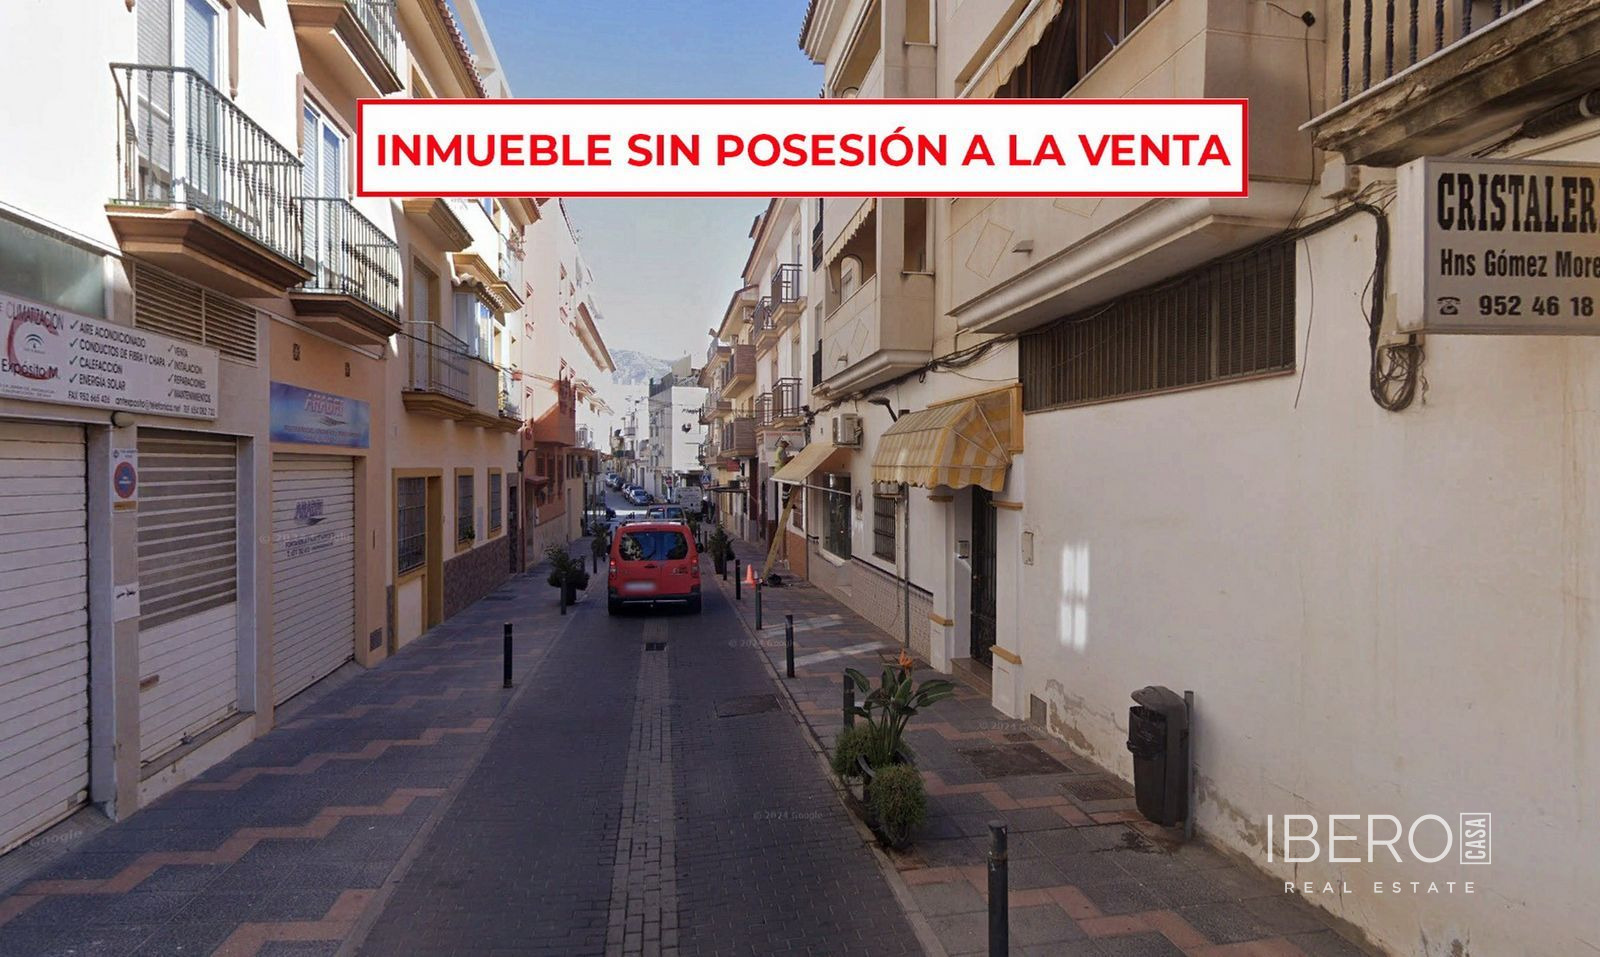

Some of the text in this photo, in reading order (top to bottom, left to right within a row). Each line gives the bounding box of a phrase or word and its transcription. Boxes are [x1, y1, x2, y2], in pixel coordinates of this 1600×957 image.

[1437, 172, 1600, 233] CRISTALER
[1440, 248, 1476, 276] Hns
[1484, 249, 1548, 278] Gómez
[1479, 295, 1594, 317] 952 46 18
[79, 322, 146, 348] AIRE ACONDICIONADO
[79, 339, 119, 357] CONDUCTOS
[120, 348, 128, 359] DE
[129, 350, 143, 362] FIBRA
[149, 355, 166, 367] CHAPA
[2, 358, 46, 377] Expósito
[107, 377, 126, 391] SOLAR
